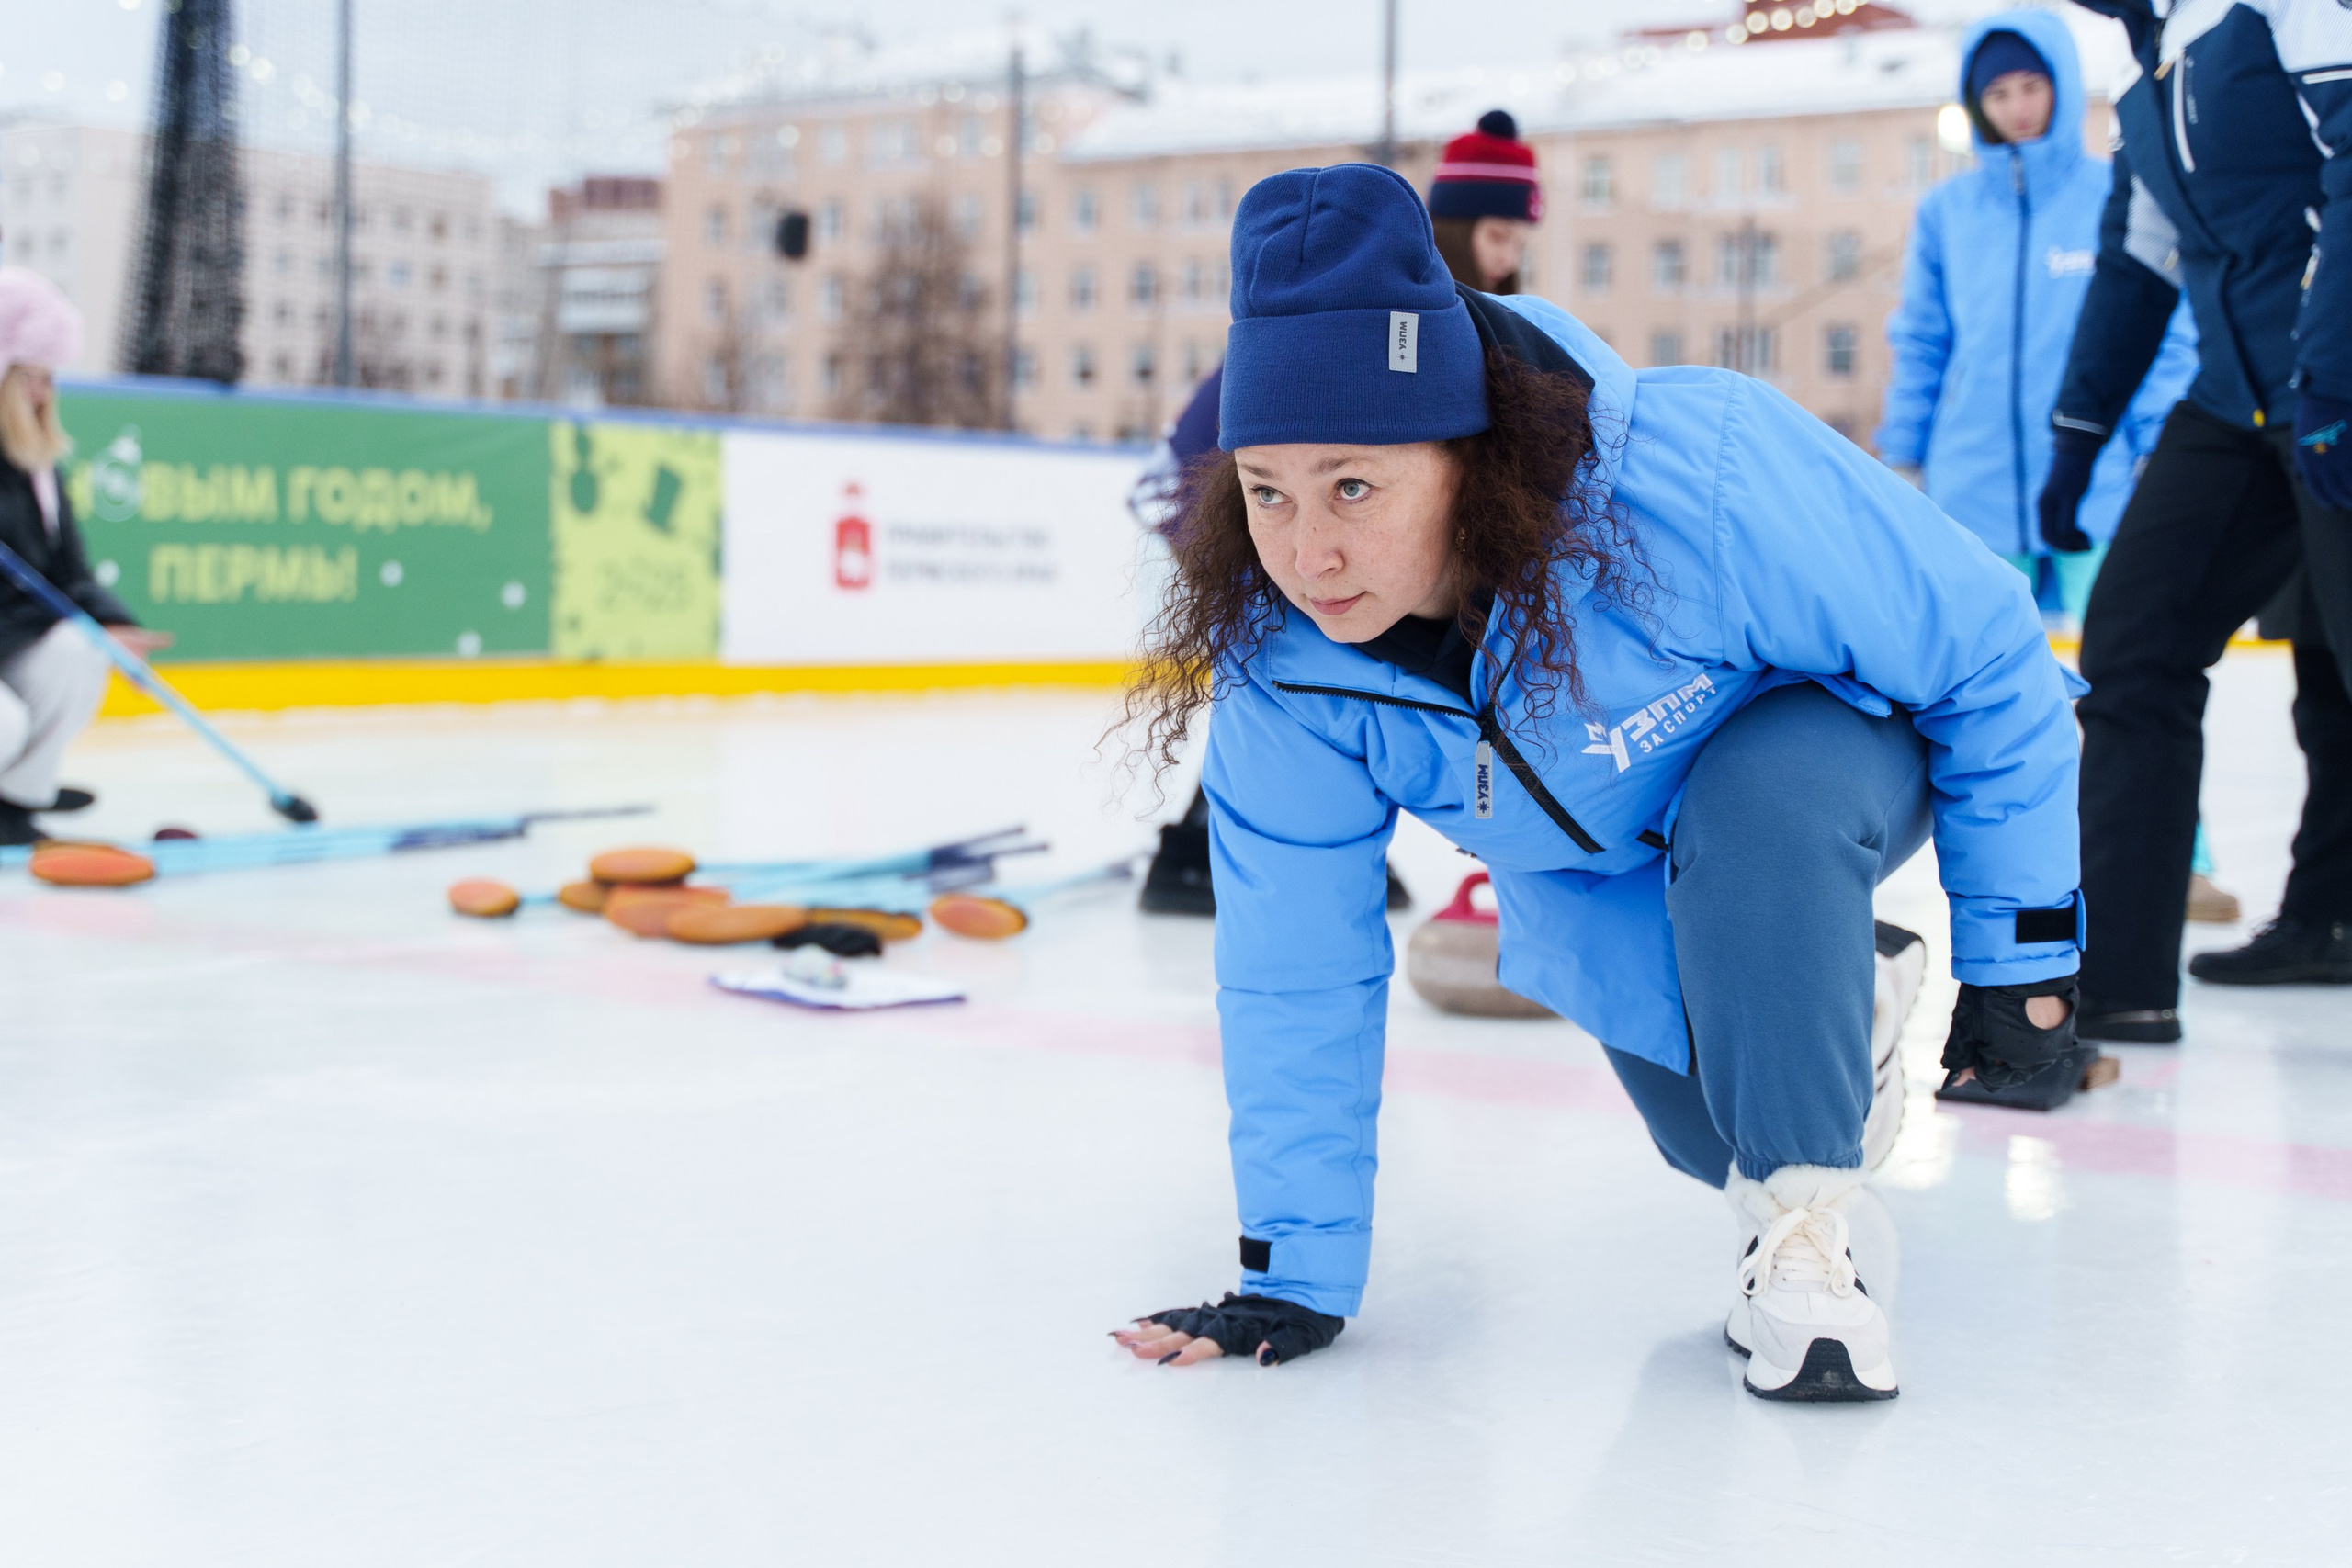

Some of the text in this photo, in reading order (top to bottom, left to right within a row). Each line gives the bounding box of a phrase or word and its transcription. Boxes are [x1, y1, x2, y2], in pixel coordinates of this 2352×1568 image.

[1399, 321, 1408, 350] УЗПМ
[288, 466, 493, 531] ГОДОМ,
[150, 543, 358, 603] ПЕРМЬ!
[1580, 673, 1713, 773] УЗПМ
[1639, 686, 1716, 753] ЗА СПОРТ
[1477, 764, 1488, 799] УЗПМ
